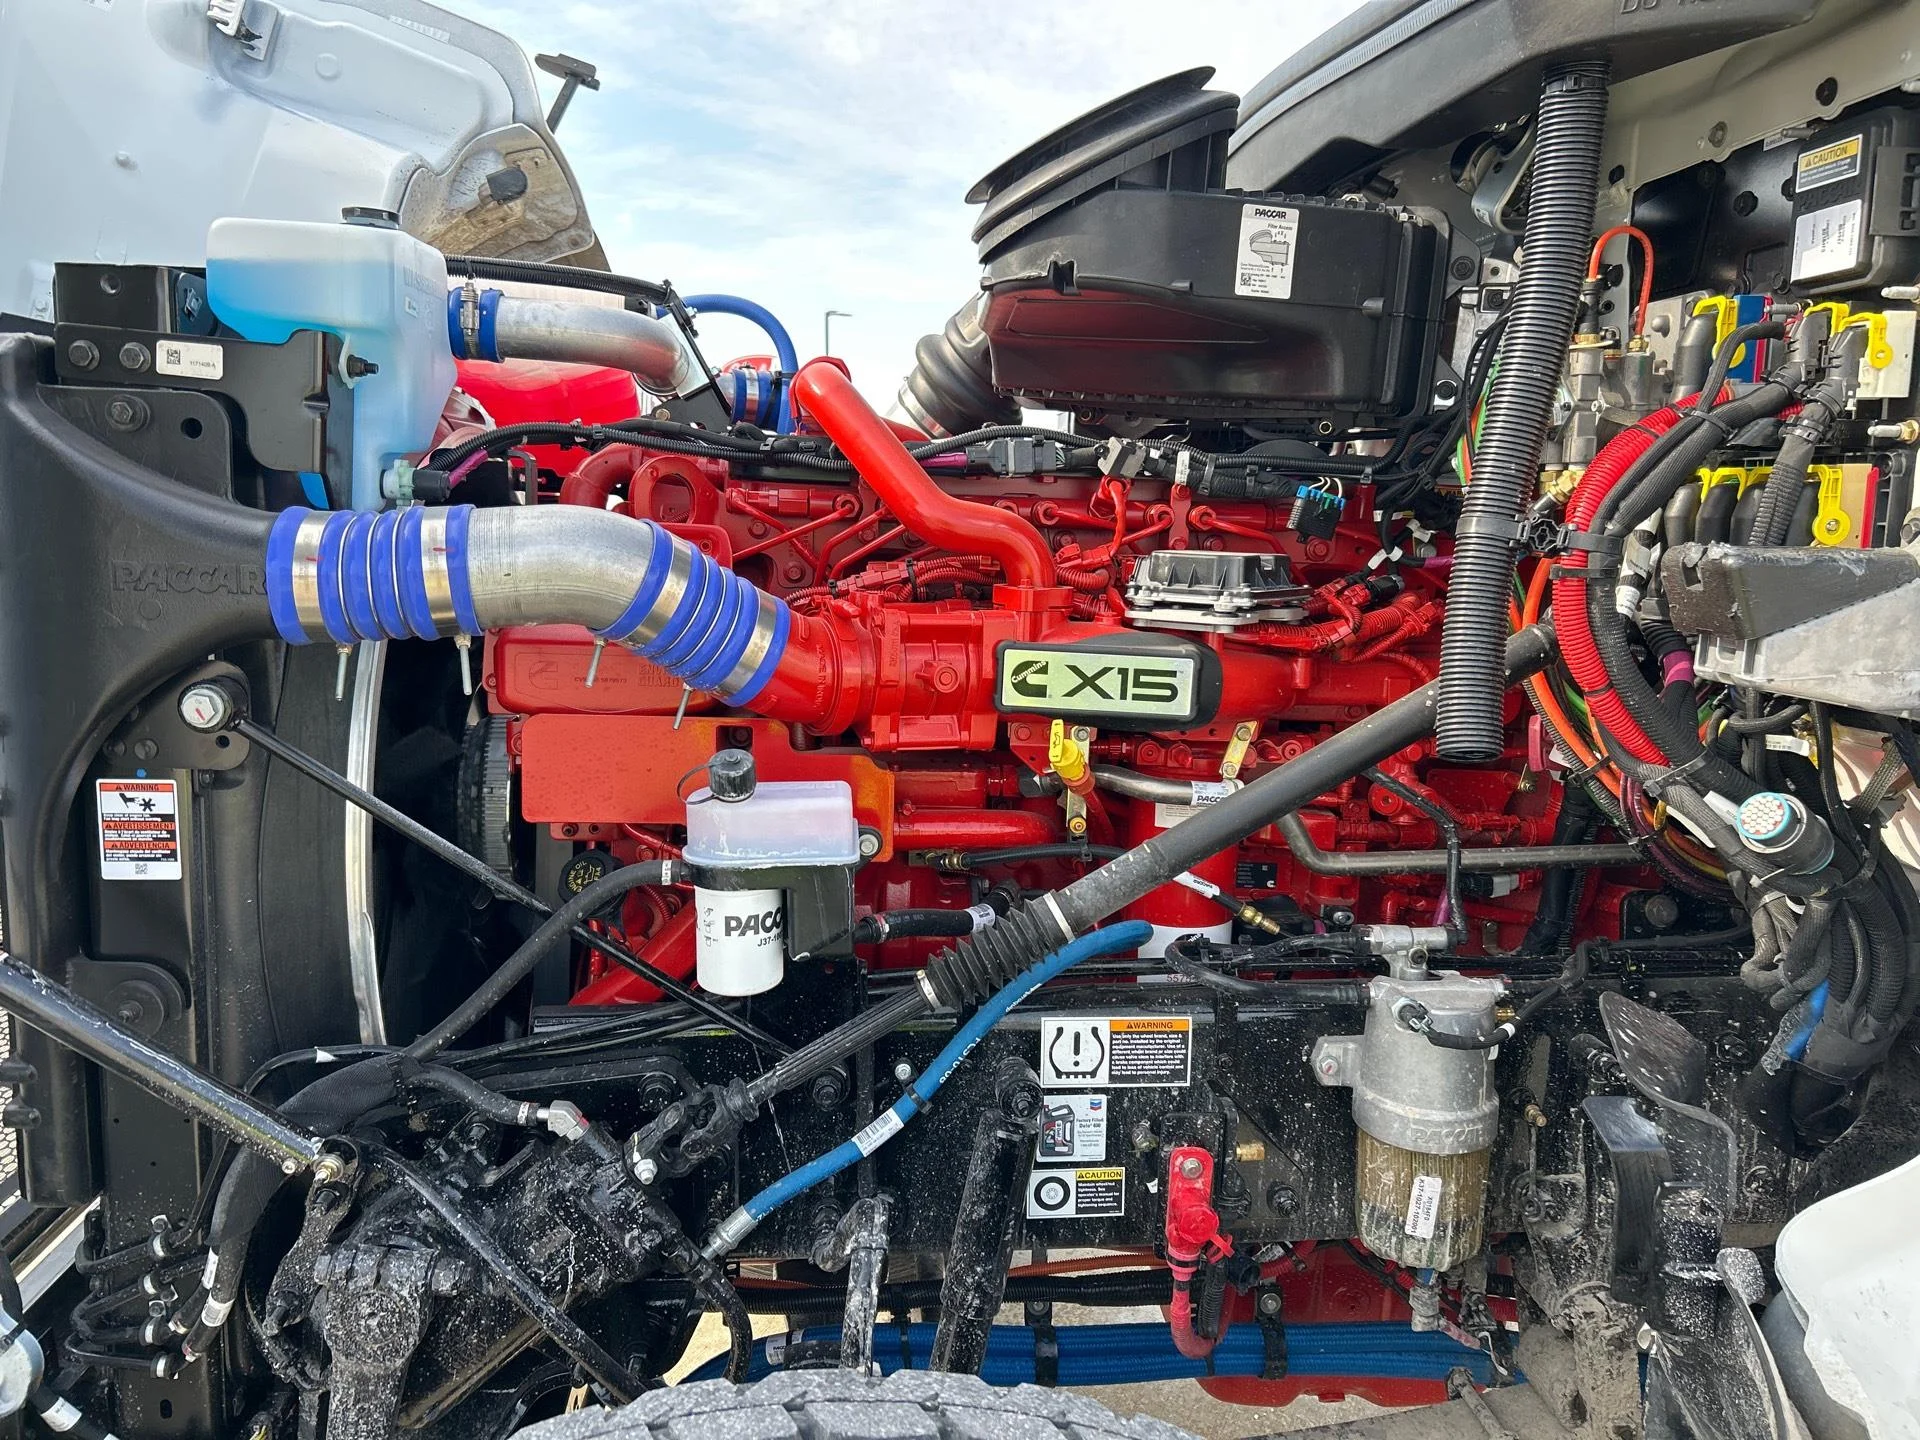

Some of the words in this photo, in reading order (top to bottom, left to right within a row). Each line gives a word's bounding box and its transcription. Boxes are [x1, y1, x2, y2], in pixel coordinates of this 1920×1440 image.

[1812, 145, 1848, 164] CAUTION
[1254, 208, 1286, 219] PACCAR
[112, 559, 268, 595] PACCAR
[1011, 660, 1047, 684] Cummins
[1061, 664, 1179, 703] X15
[576, 861, 587, 870] OIL
